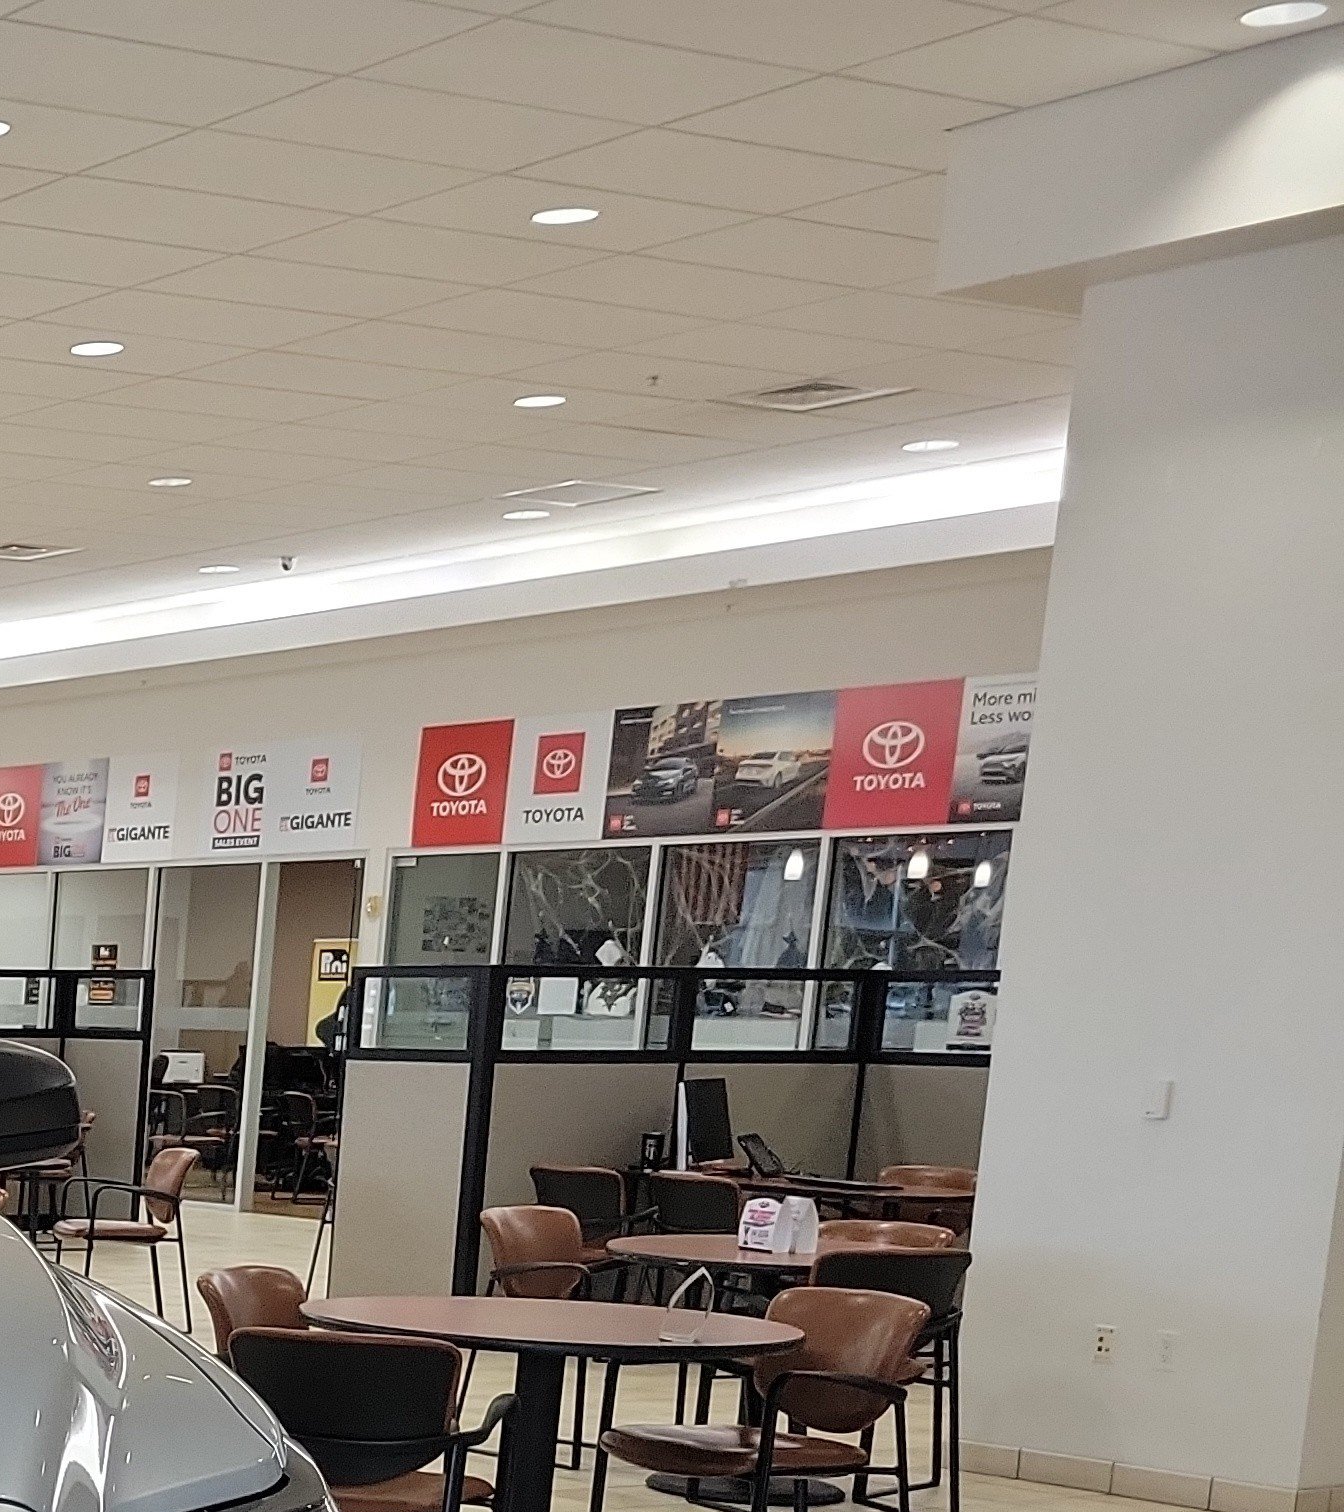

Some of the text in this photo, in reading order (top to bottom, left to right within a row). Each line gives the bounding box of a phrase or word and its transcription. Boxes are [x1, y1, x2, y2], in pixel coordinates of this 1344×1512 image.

[973, 692, 1013, 708] More
[970, 710, 1034, 725] Less wo
[234, 754, 267, 765] TOYOTA
[215, 773, 265, 807] BIG
[852, 772, 926, 791] TOYOTA
[430, 799, 487, 818] TOYOTA
[523, 807, 584, 825] TOYOTA
[213, 808, 263, 834] ONE
[290, 811, 352, 830] GIGANTE
[116, 825, 170, 842] GIGANTE
[53, 845, 71, 858] BIG
